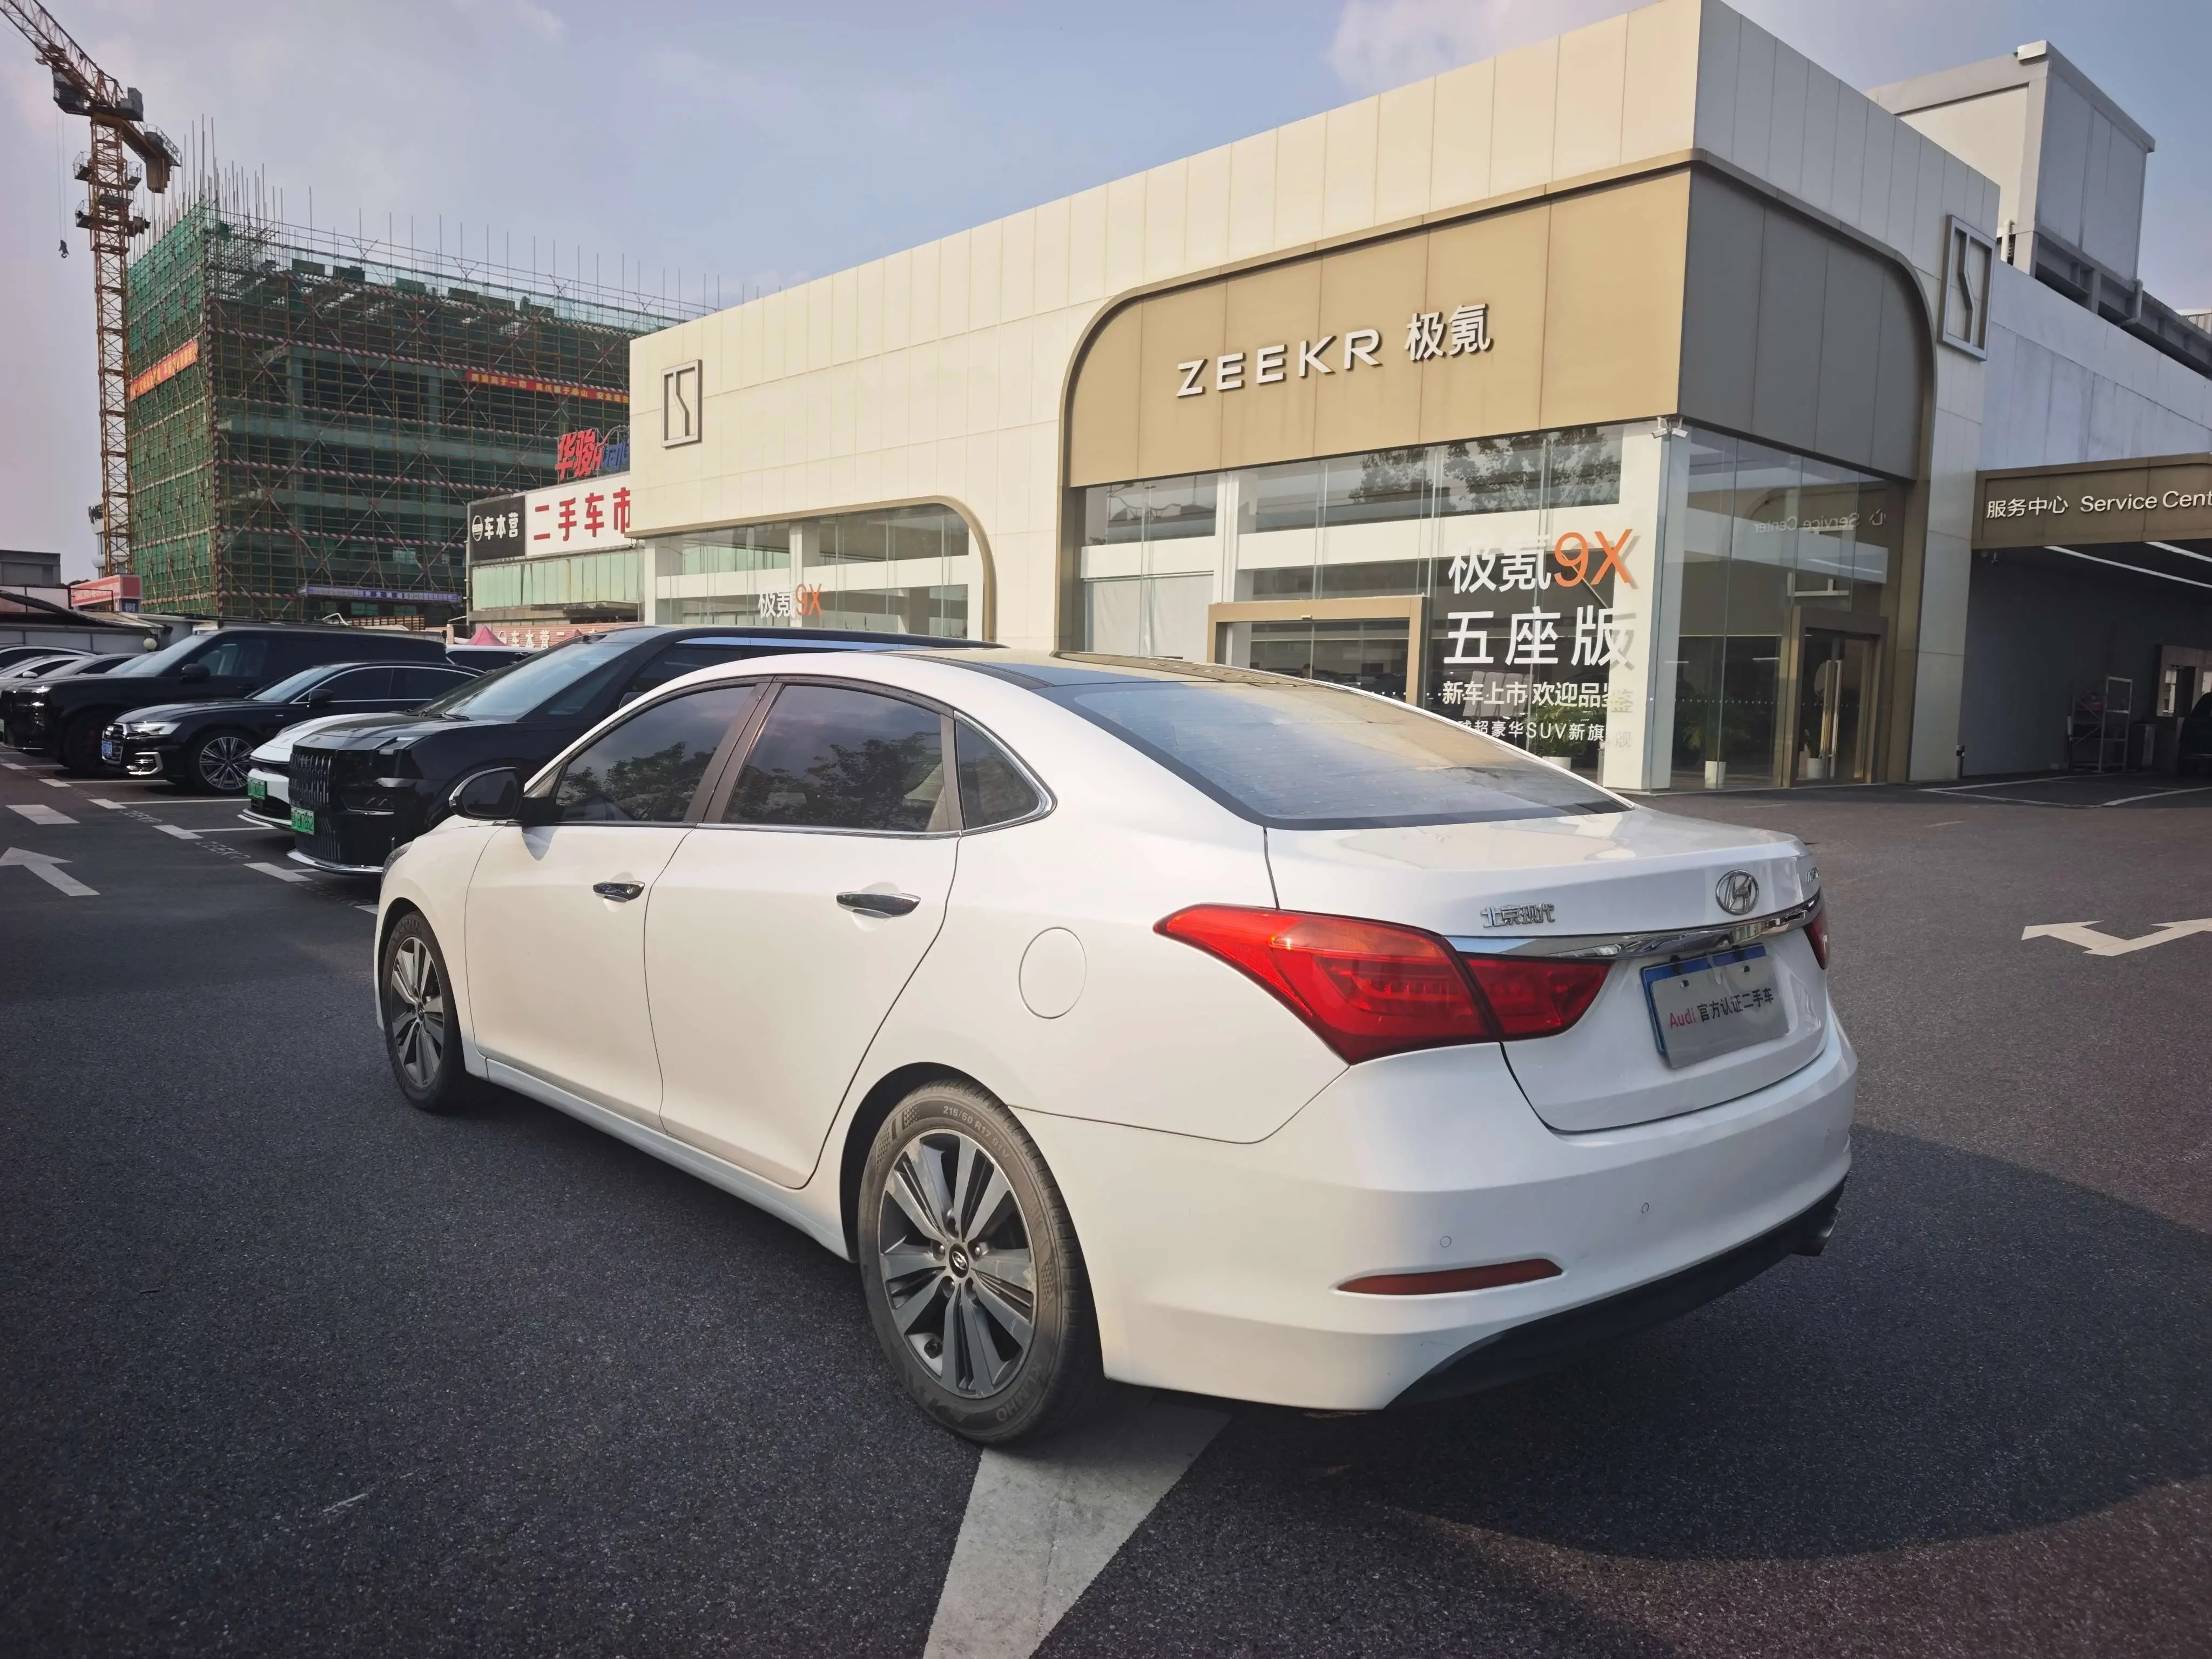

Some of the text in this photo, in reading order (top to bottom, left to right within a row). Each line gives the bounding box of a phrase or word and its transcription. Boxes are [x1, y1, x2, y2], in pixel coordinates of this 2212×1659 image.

[1176, 302, 1494, 397] ZEEKR 极氪
[555, 428, 596, 481] 华骏
[484, 511, 519, 540] 车本营
[533, 487, 631, 542] 二手车市
[1986, 490, 2212, 519] 服务中心 Service Cent
[1448, 529, 1633, 595] 极氪9X
[1444, 605, 1630, 666] 五座版
[1442, 680, 1528, 706] 新车上市
[1480, 902, 1555, 928] 北京现代
[1669, 987, 1774, 1029] Audi 官方认证二手车
[942, 1105, 974, 1124] 215/50
[974, 1120, 992, 1137] R17
[996, 1361, 1043, 1422] KUMHO
